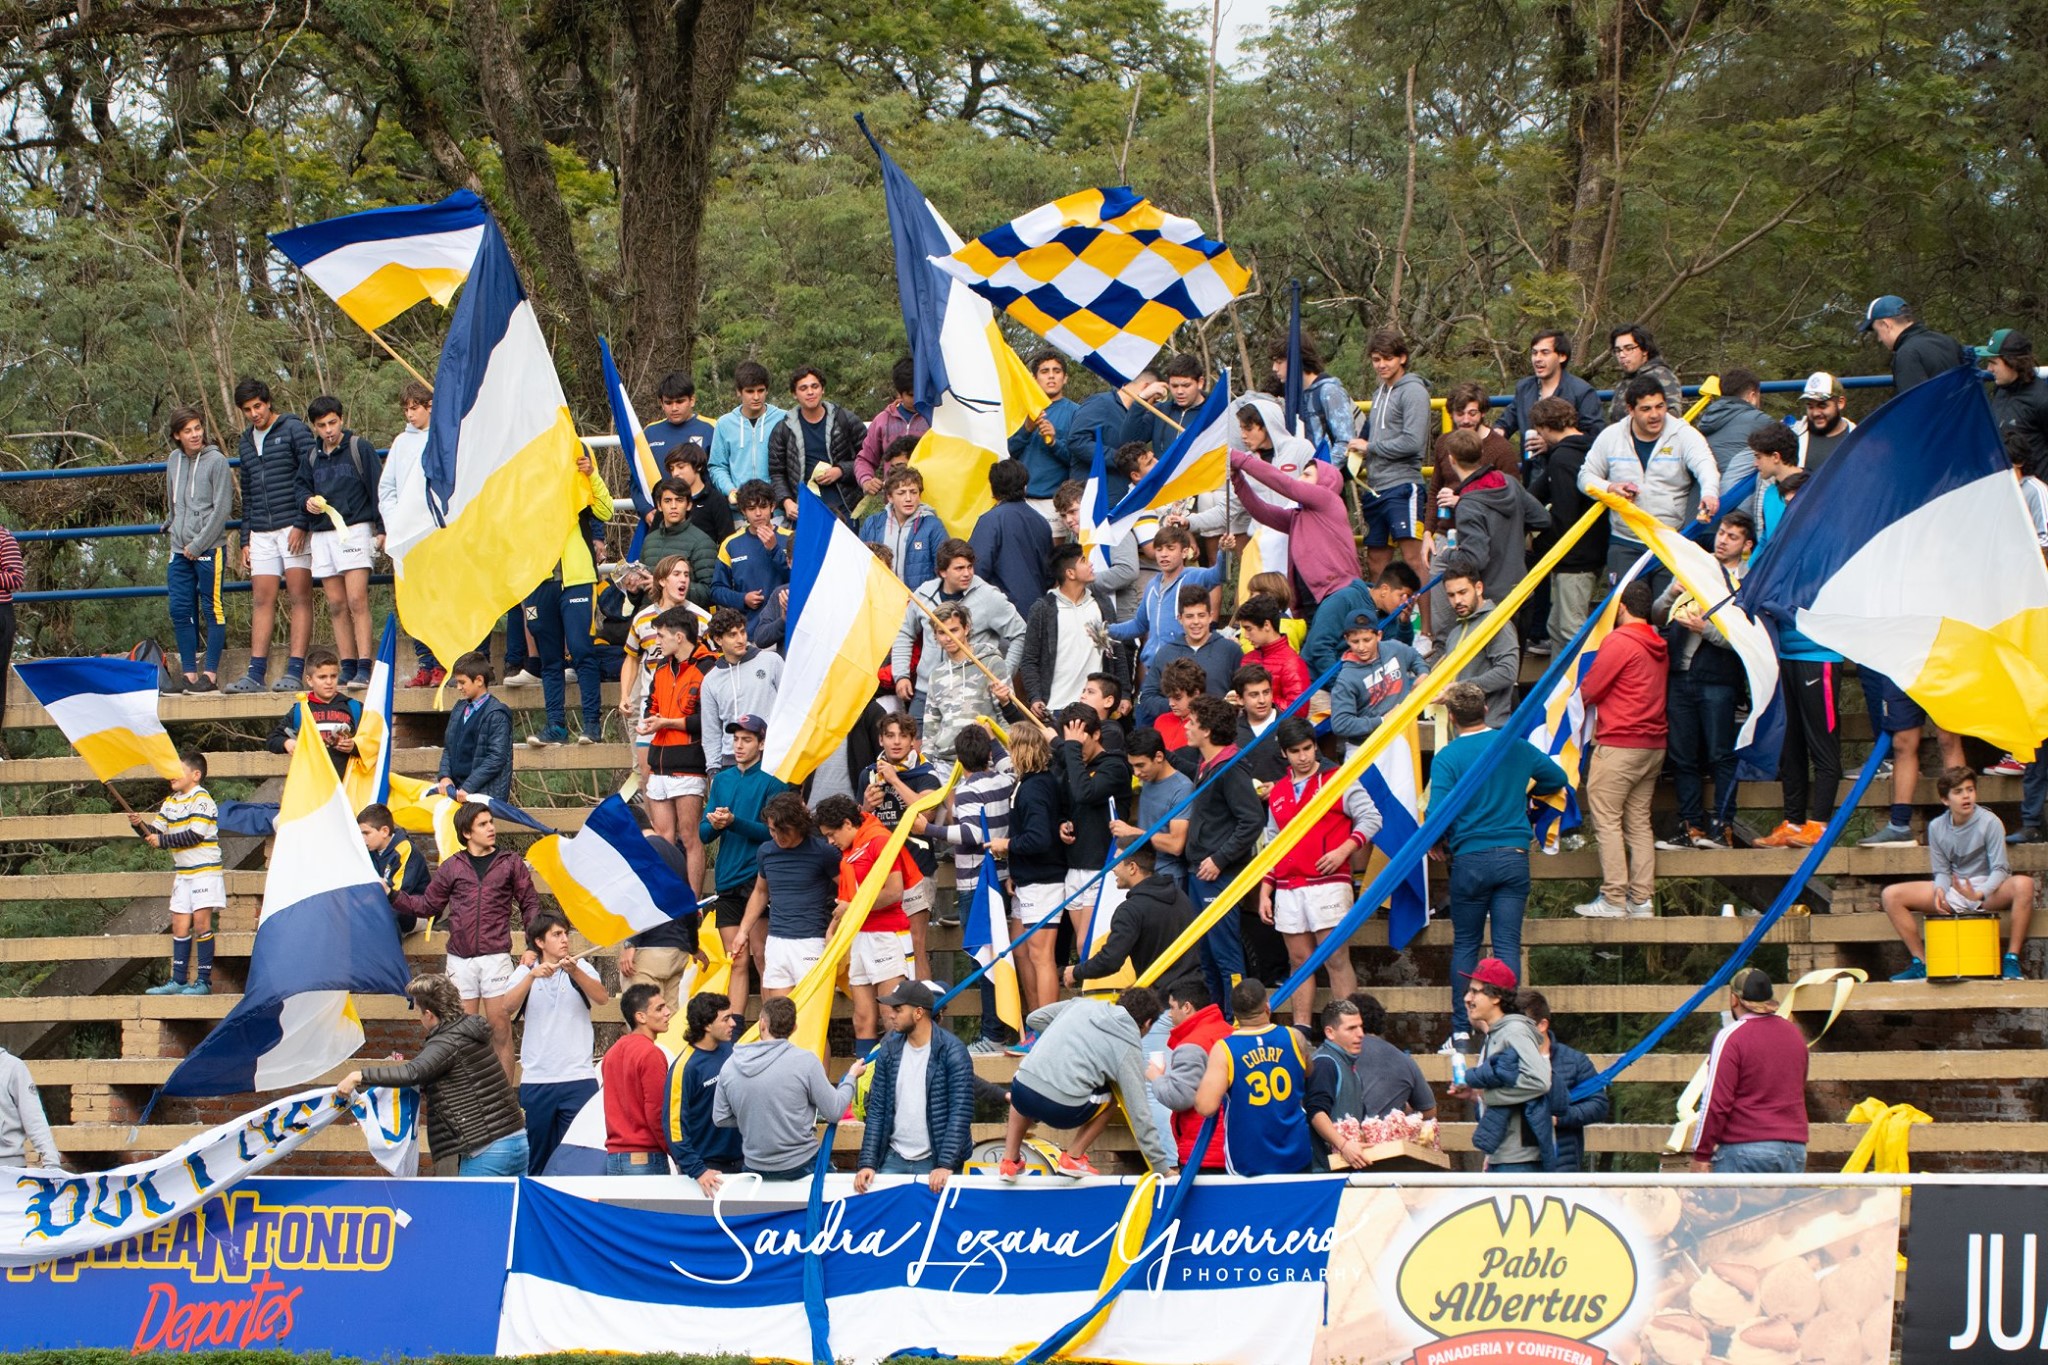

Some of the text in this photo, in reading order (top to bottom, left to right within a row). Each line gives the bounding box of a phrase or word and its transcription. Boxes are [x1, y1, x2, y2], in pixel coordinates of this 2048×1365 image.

[1242, 1046, 1283, 1069] CURRY
[1245, 1066, 1292, 1106] 30
[1478, 1246, 1568, 1279] Pablo
[1429, 1281, 1608, 1323] Albertus
[1949, 1233, 2048, 1352] JU
[131, 1270, 304, 1357] Deportes
[1428, 1340, 1593, 1365] PANADERIA Y CONFITERIA
